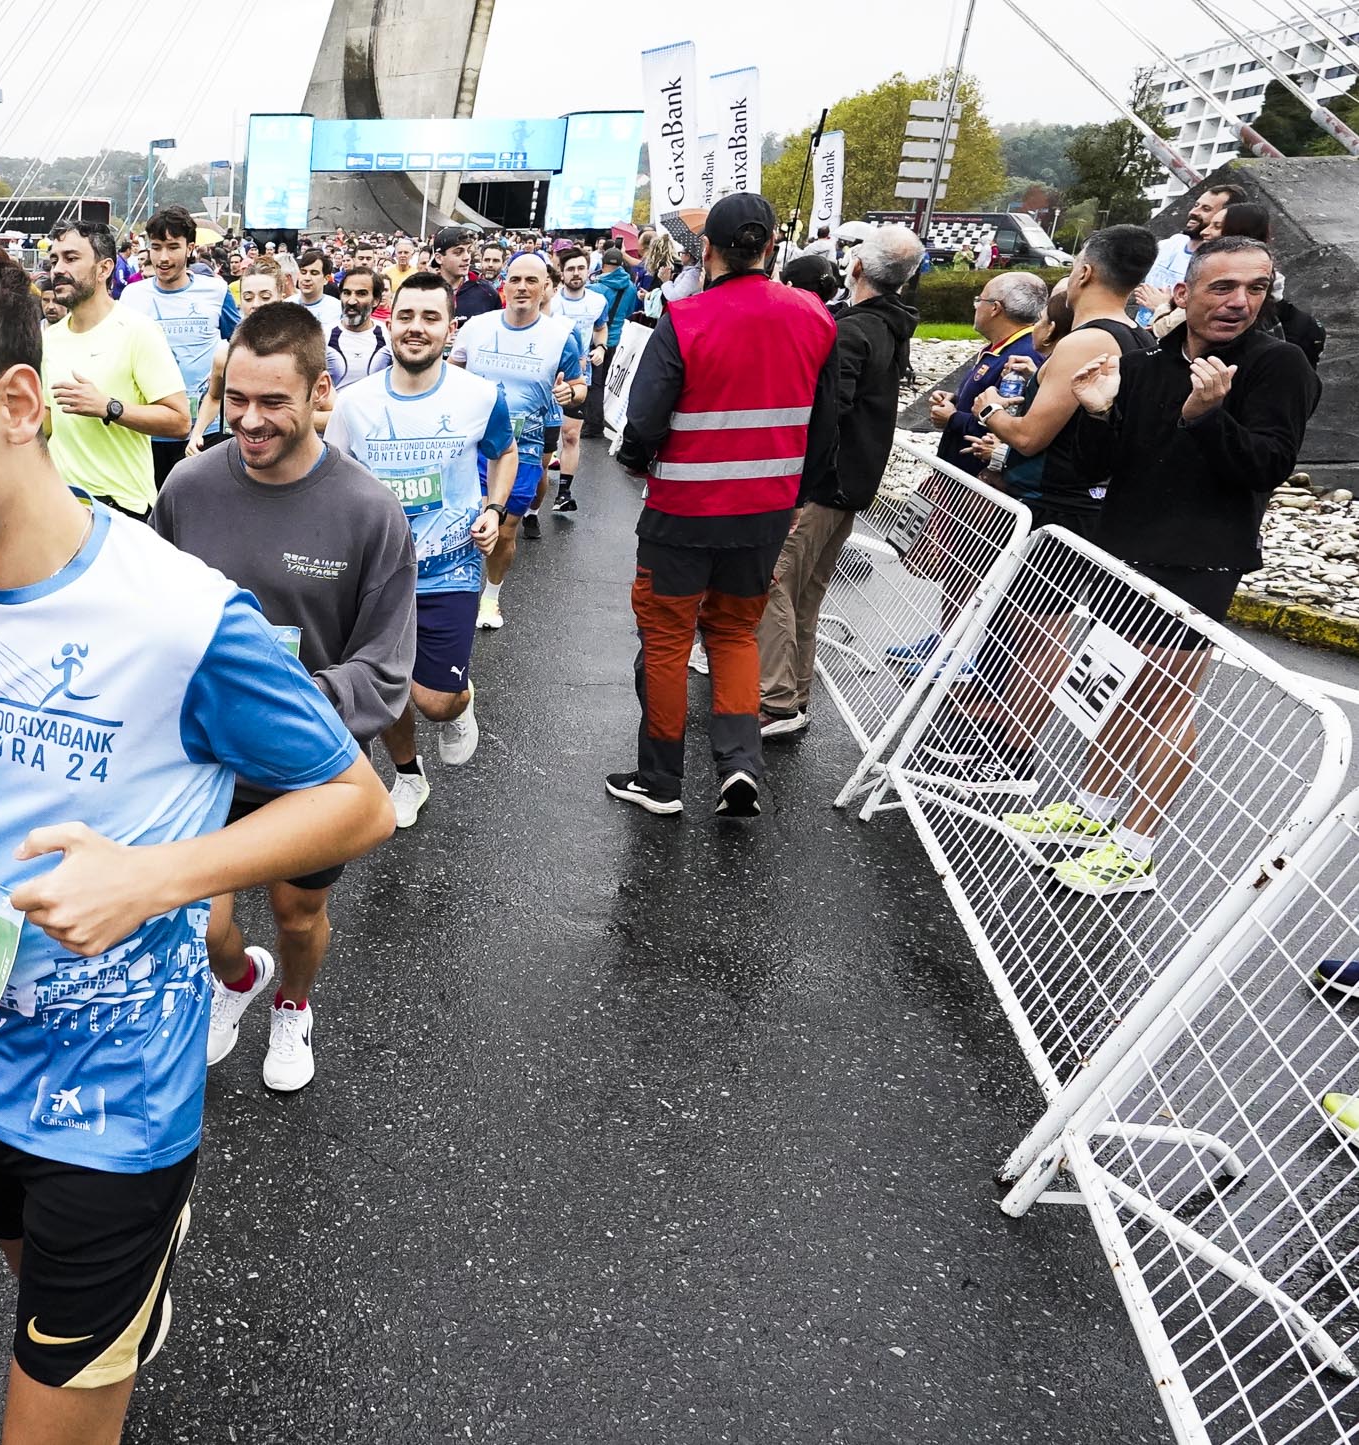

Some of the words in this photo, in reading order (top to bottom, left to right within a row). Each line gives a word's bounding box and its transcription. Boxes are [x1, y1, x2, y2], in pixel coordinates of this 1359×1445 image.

[660, 76, 685, 206] CaixaBank
[728, 96, 748, 190] aixaBank
[701, 151, 716, 206] aixaBank
[817, 150, 836, 221] CaixaBank
[367, 450, 443, 462] PONTEVEDRA
[449, 448, 463, 459] 24
[380, 442, 398, 451] GRAN
[400, 441, 423, 450] FONDO
[425, 441, 465, 450] CAIXABANK
[282, 552, 348, 571] RECLAIMED
[287, 562, 339, 580] VINTAGE
[15, 715, 116, 753] AIXABANK
[65, 753, 109, 783] 24
[41, 1114, 91, 1132] CaixaBank
